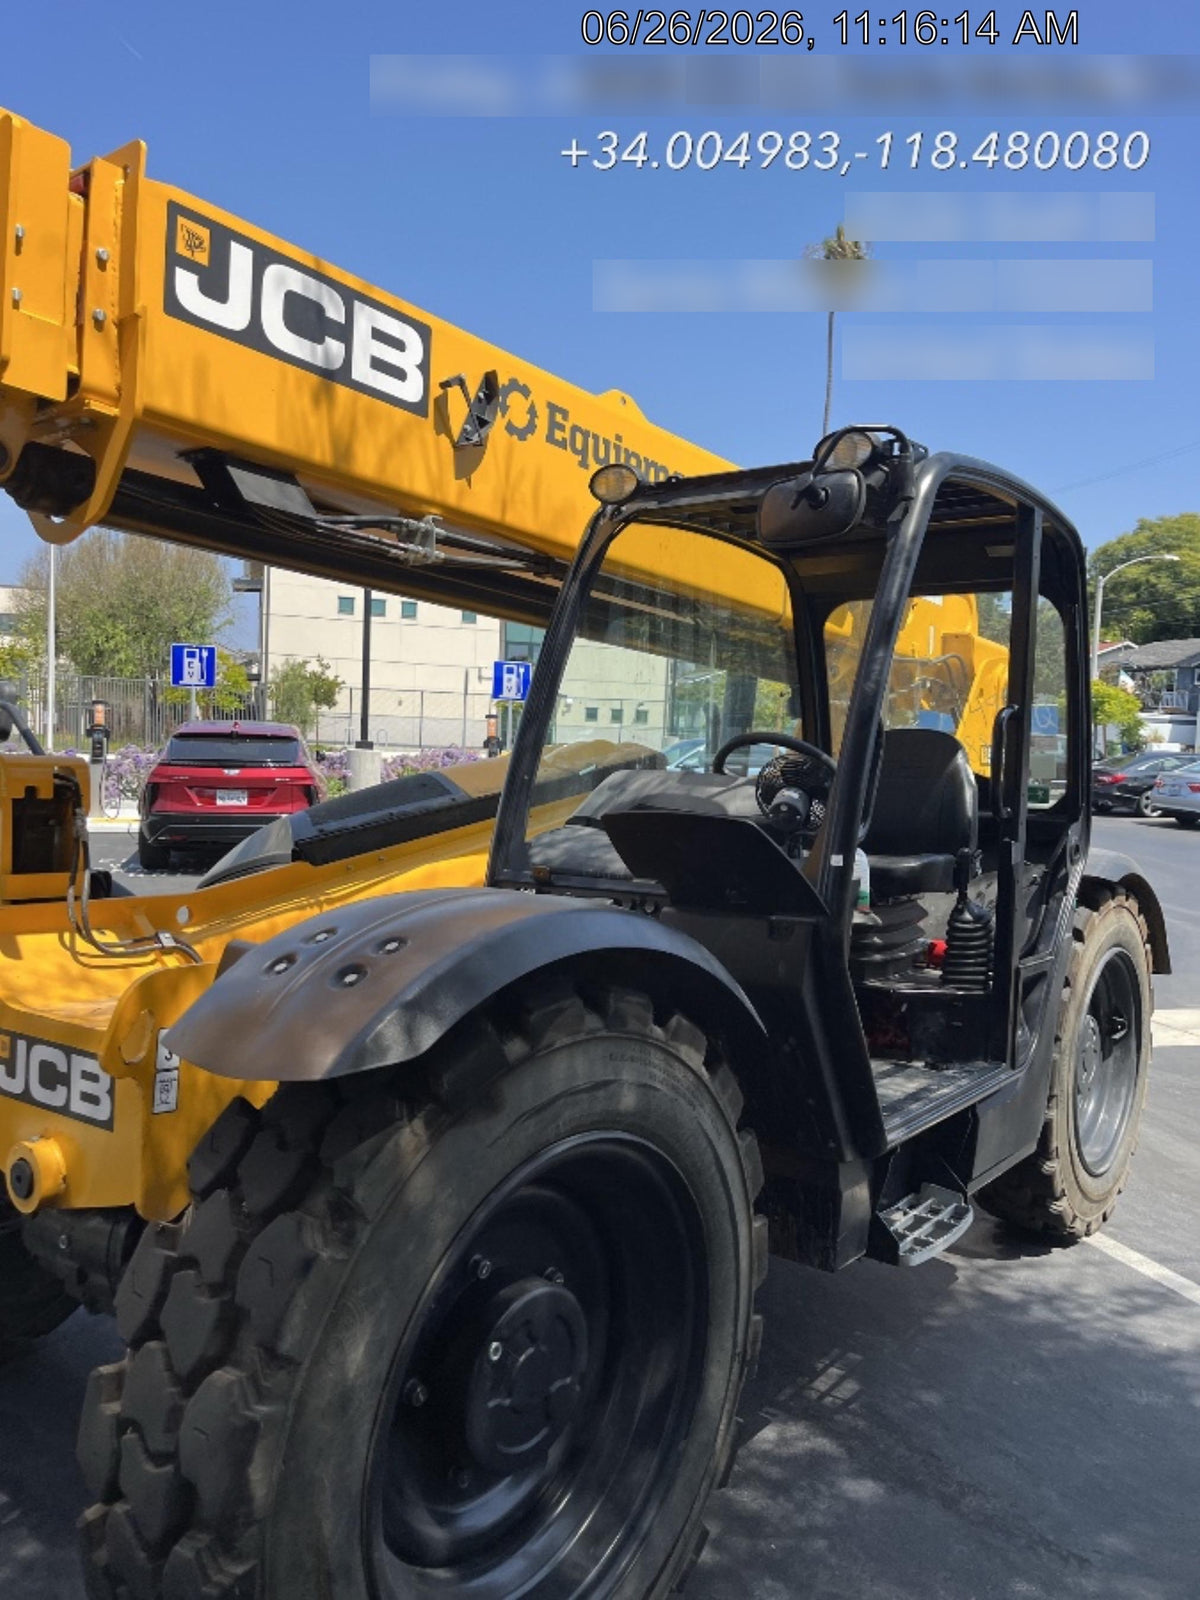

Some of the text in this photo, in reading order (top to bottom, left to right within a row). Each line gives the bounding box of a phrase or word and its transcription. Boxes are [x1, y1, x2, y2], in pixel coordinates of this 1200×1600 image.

[173, 240, 424, 404] JCB
[545, 401, 686, 482] Equipm
[0, 1039, 112, 1121] JCB
